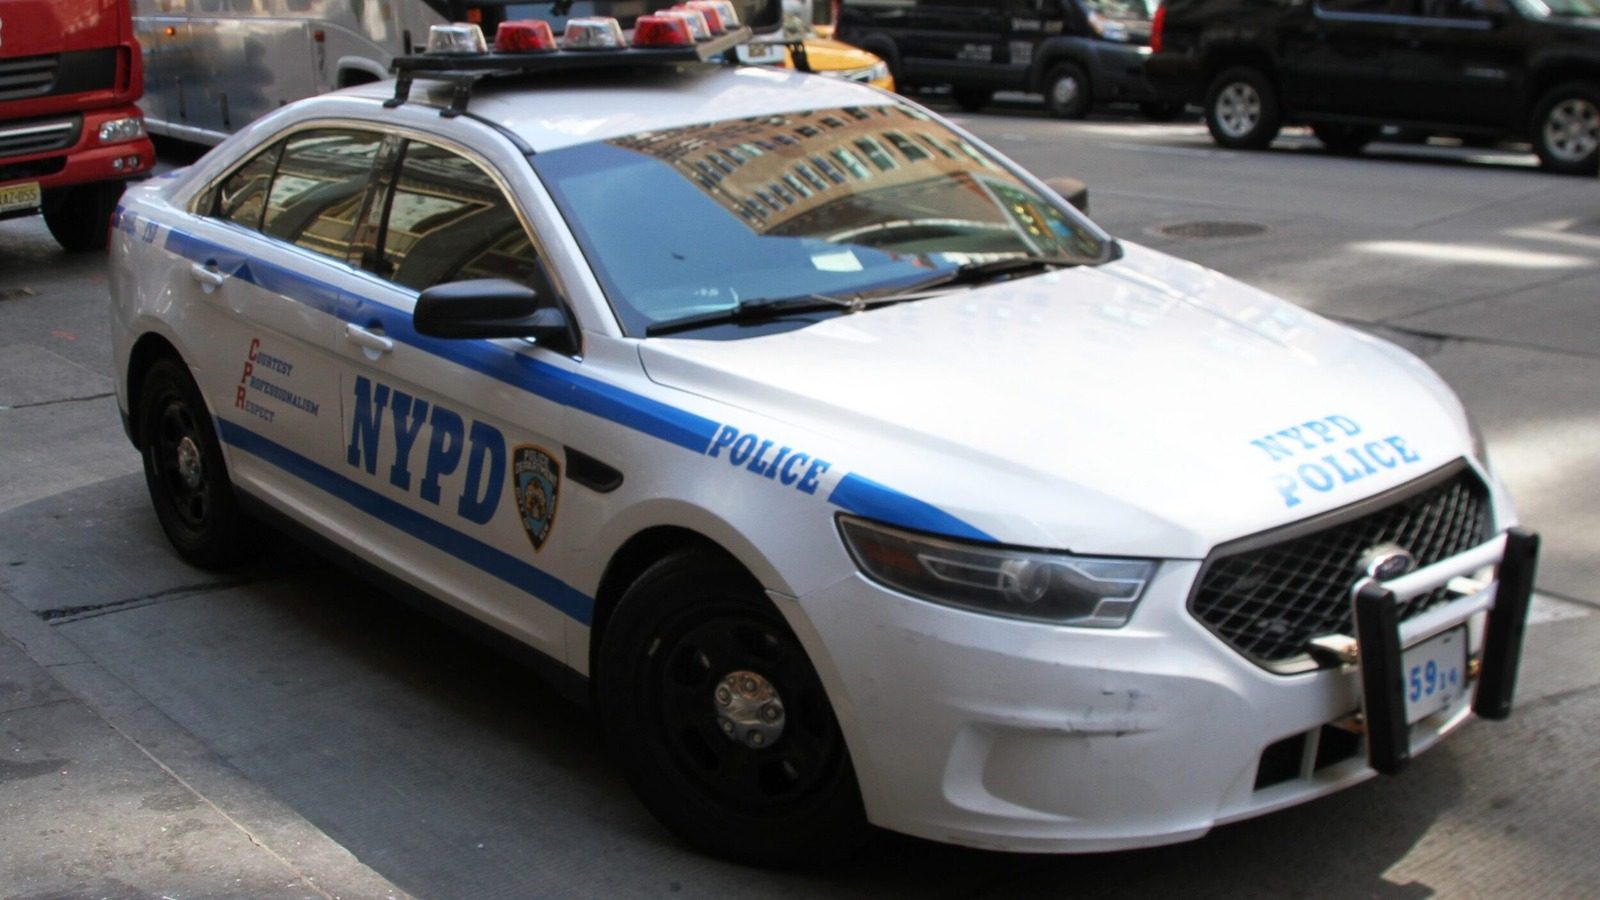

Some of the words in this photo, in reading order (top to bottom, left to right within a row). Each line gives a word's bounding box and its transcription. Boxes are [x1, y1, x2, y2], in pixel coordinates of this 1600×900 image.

[347, 375, 507, 525] NYPD
[707, 424, 832, 496] POLICE
[1249, 414, 1362, 463] NYPD
[1272, 435, 1421, 508] POLICE
